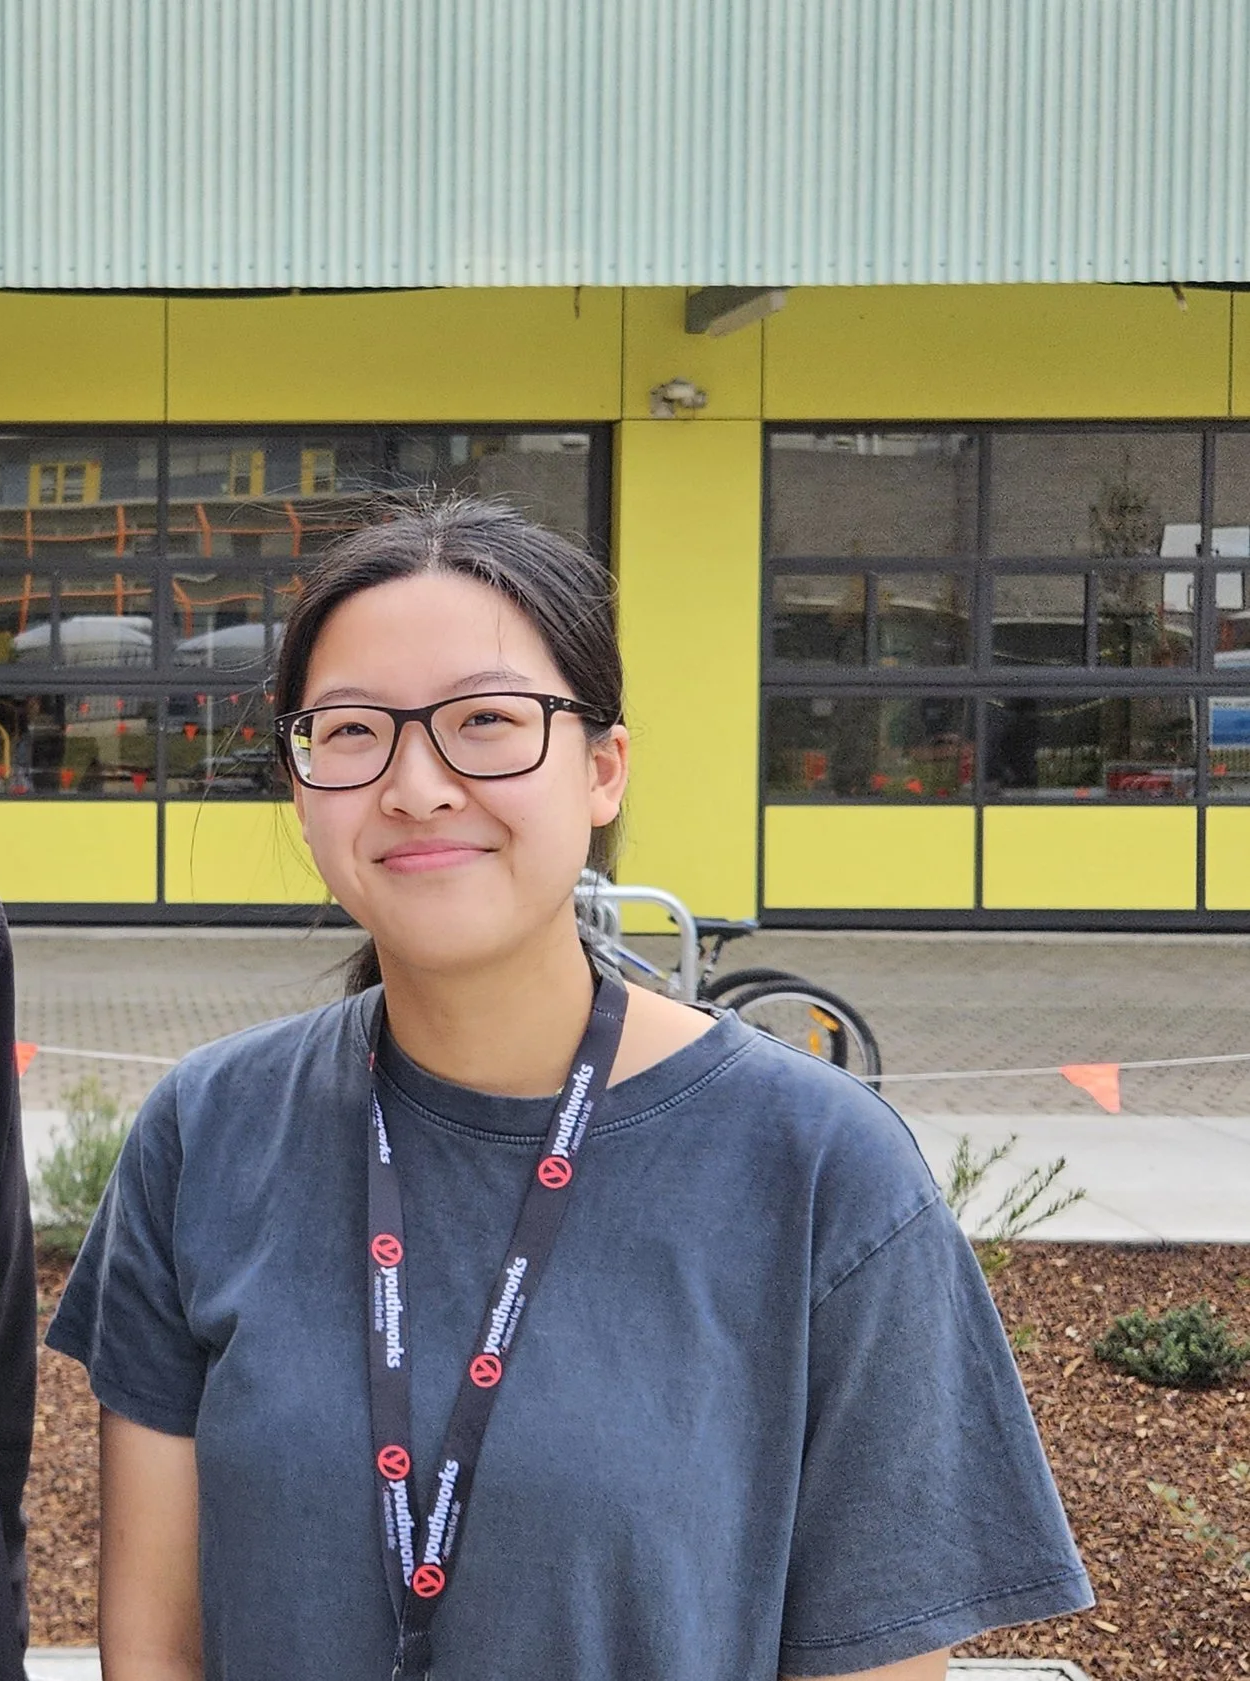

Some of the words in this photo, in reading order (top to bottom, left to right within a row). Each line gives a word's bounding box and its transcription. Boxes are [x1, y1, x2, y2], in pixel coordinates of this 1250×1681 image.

[552, 1064, 594, 1158] youthworks
[381, 1267, 405, 1368] youthworks
[483, 1256, 527, 1356] youthworks
[423, 1459, 459, 1566] youthworks
